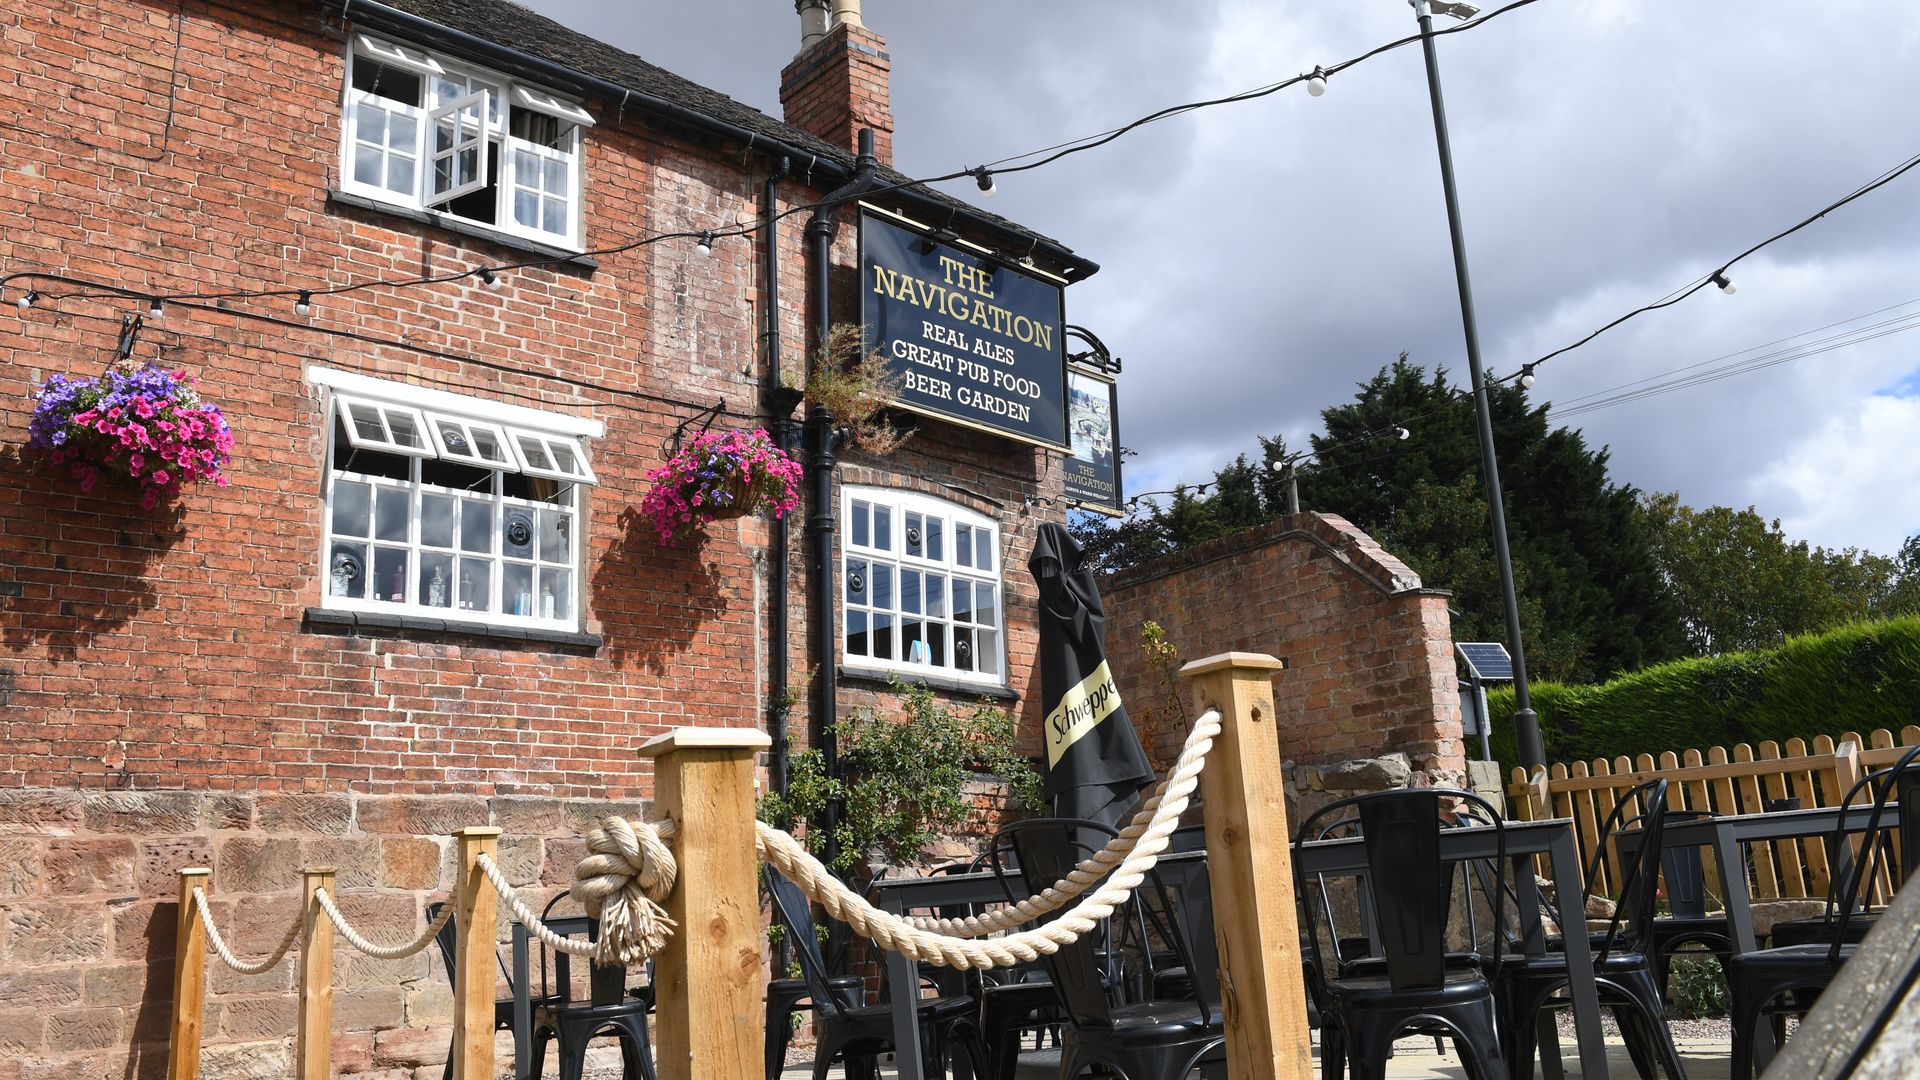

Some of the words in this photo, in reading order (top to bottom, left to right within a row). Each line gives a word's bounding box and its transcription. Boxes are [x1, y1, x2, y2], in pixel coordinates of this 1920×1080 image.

[940, 255, 994, 299] THE
[873, 264, 1053, 351] NAVIGATION
[922, 320, 969, 351] REAL
[973, 338, 1015, 365] ALES
[892, 339, 954, 373] GREAT
[957, 358, 989, 383] PUB
[993, 369, 1041, 399] FOOD
[905, 370, 952, 400] BEER
[957, 386, 1031, 423] GARDEN
[1078, 464, 1095, 477] THE
